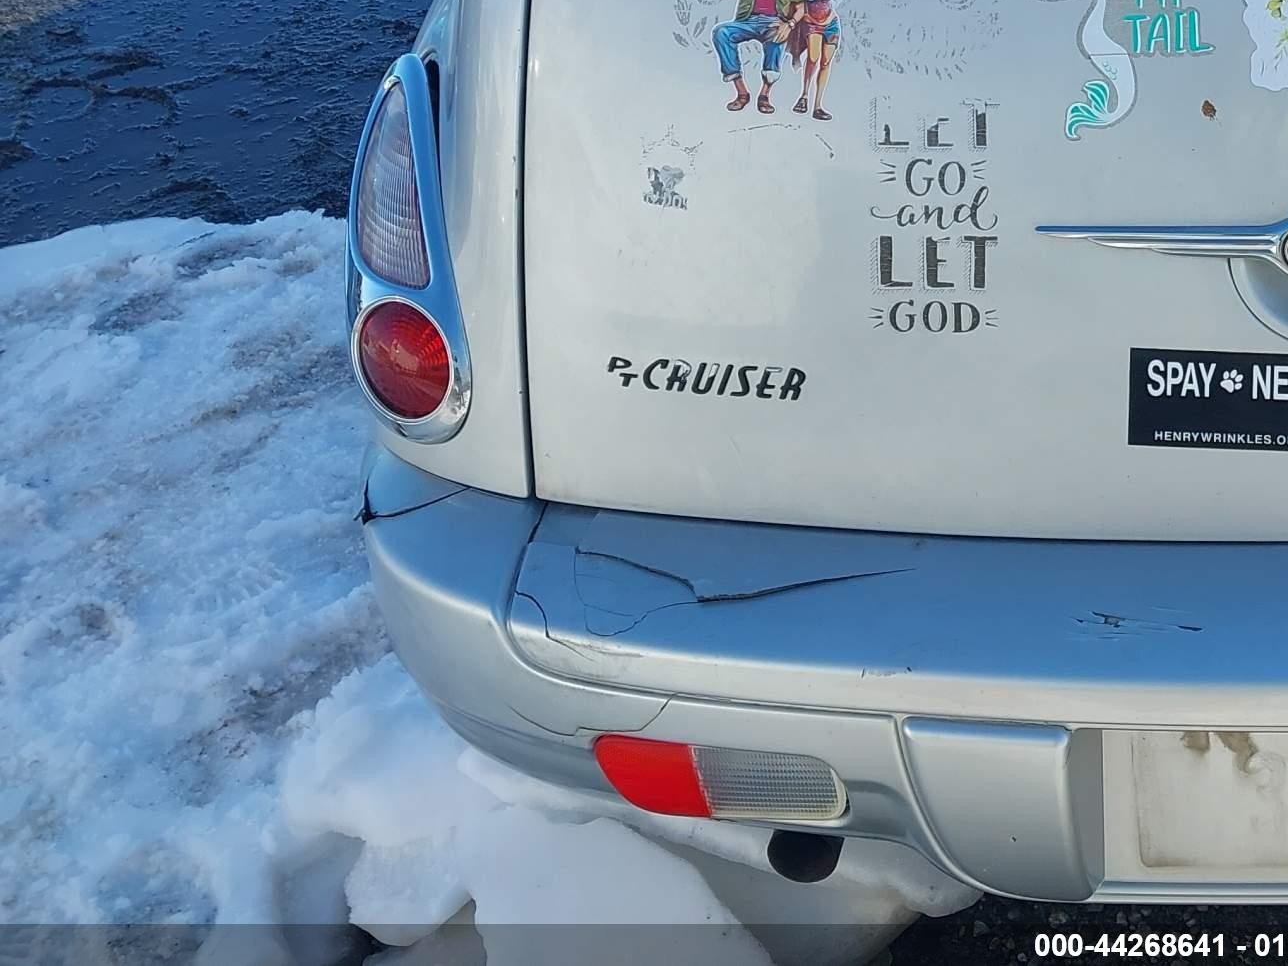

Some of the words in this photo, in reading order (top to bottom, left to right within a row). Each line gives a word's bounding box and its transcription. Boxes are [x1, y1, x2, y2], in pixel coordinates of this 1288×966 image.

[1121, 10, 1216, 54] TAIL
[905, 158, 966, 196] GO
[870, 186, 998, 231] and
[874, 236, 998, 291] LET
[889, 299, 981, 333] GOD
[642, 358, 806, 401] CRUISER
[1146, 359, 1216, 398] SPAY
